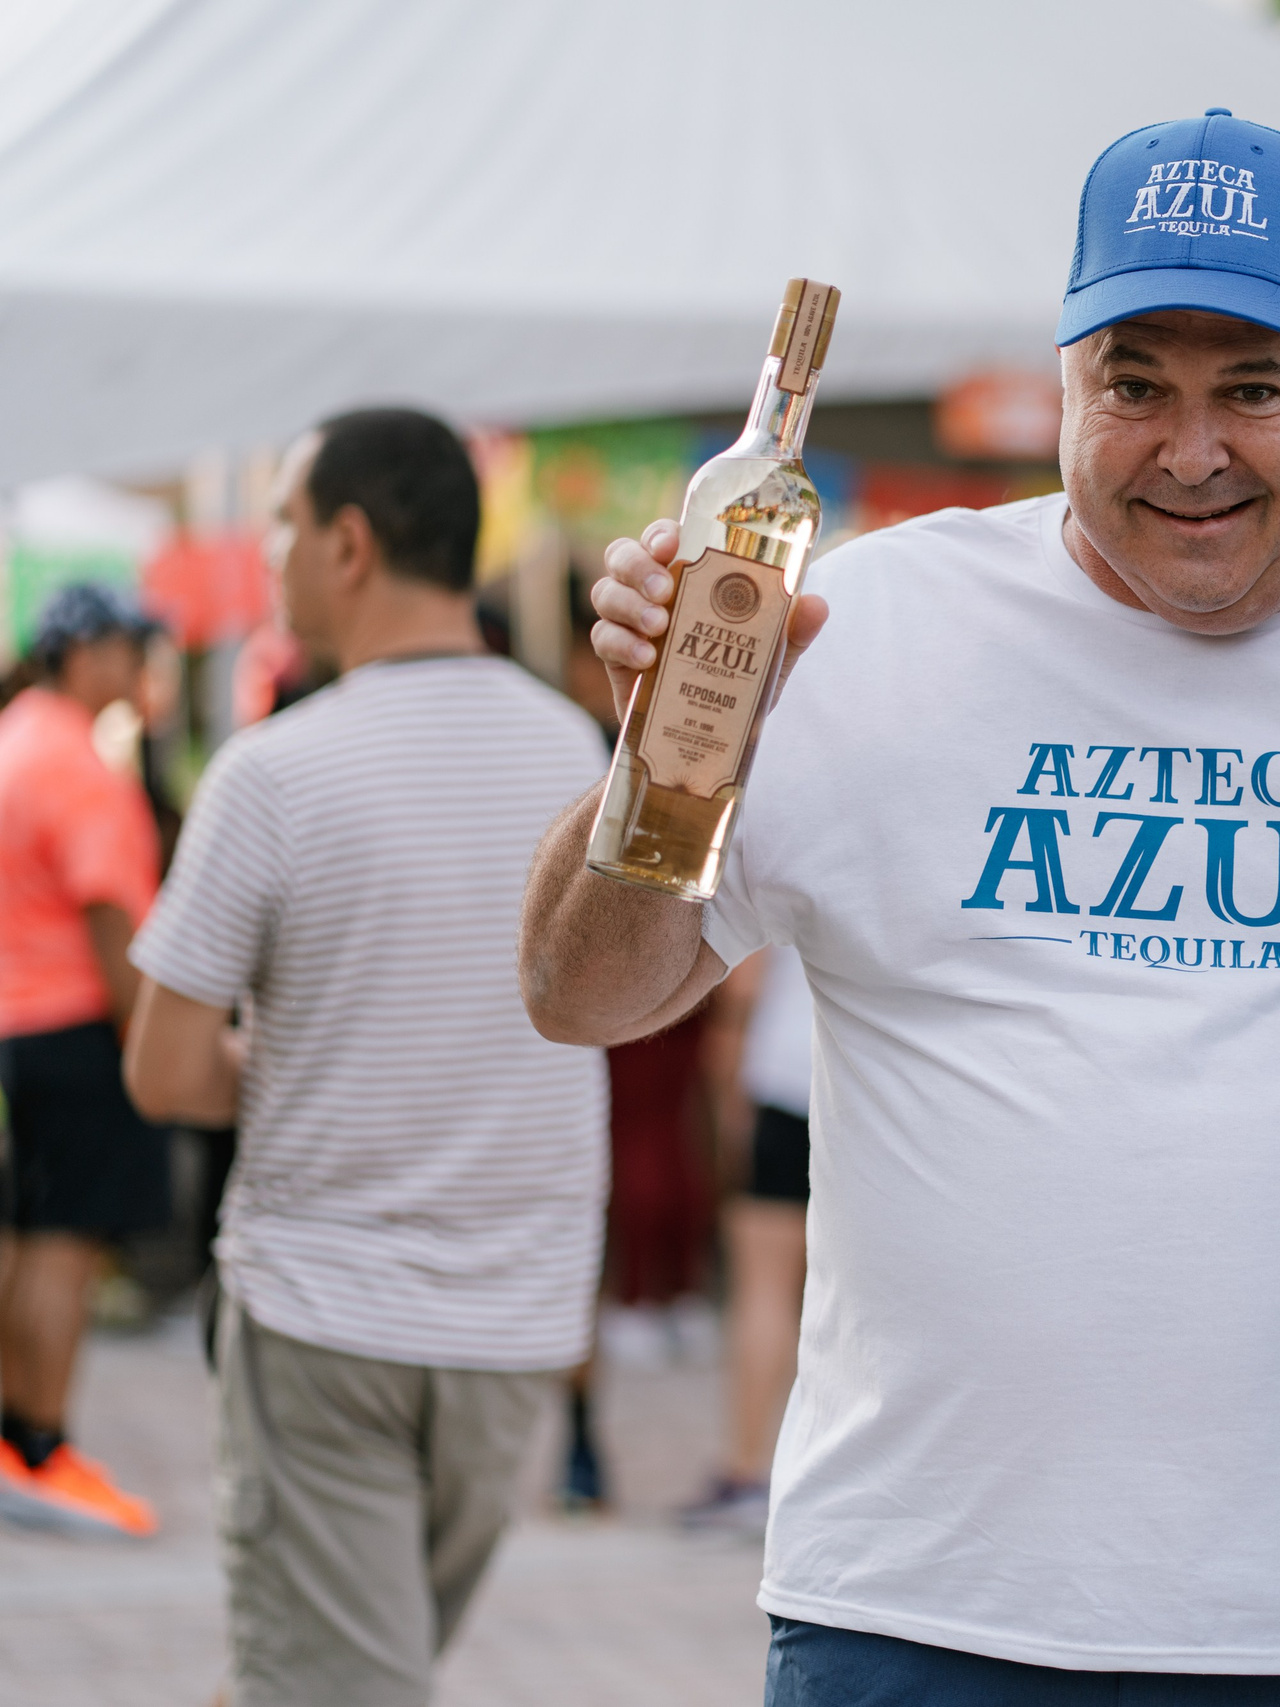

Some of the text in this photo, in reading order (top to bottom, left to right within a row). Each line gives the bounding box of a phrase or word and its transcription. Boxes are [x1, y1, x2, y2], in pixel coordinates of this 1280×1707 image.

[1146, 160, 1256, 191] AZTECA
[1126, 182, 1268, 229] AZUL
[1158, 221, 1230, 237] TEQUILA
[793, 293, 820, 375] TEQUILA 100% AGAVE AZUL
[691, 621, 756, 650] AZTECA
[676, 633, 758, 676] AZUL
[695, 661, 735, 680] TEQUILA
[679, 682, 737, 709] REPOSADO
[683, 717, 698, 728] EST.
